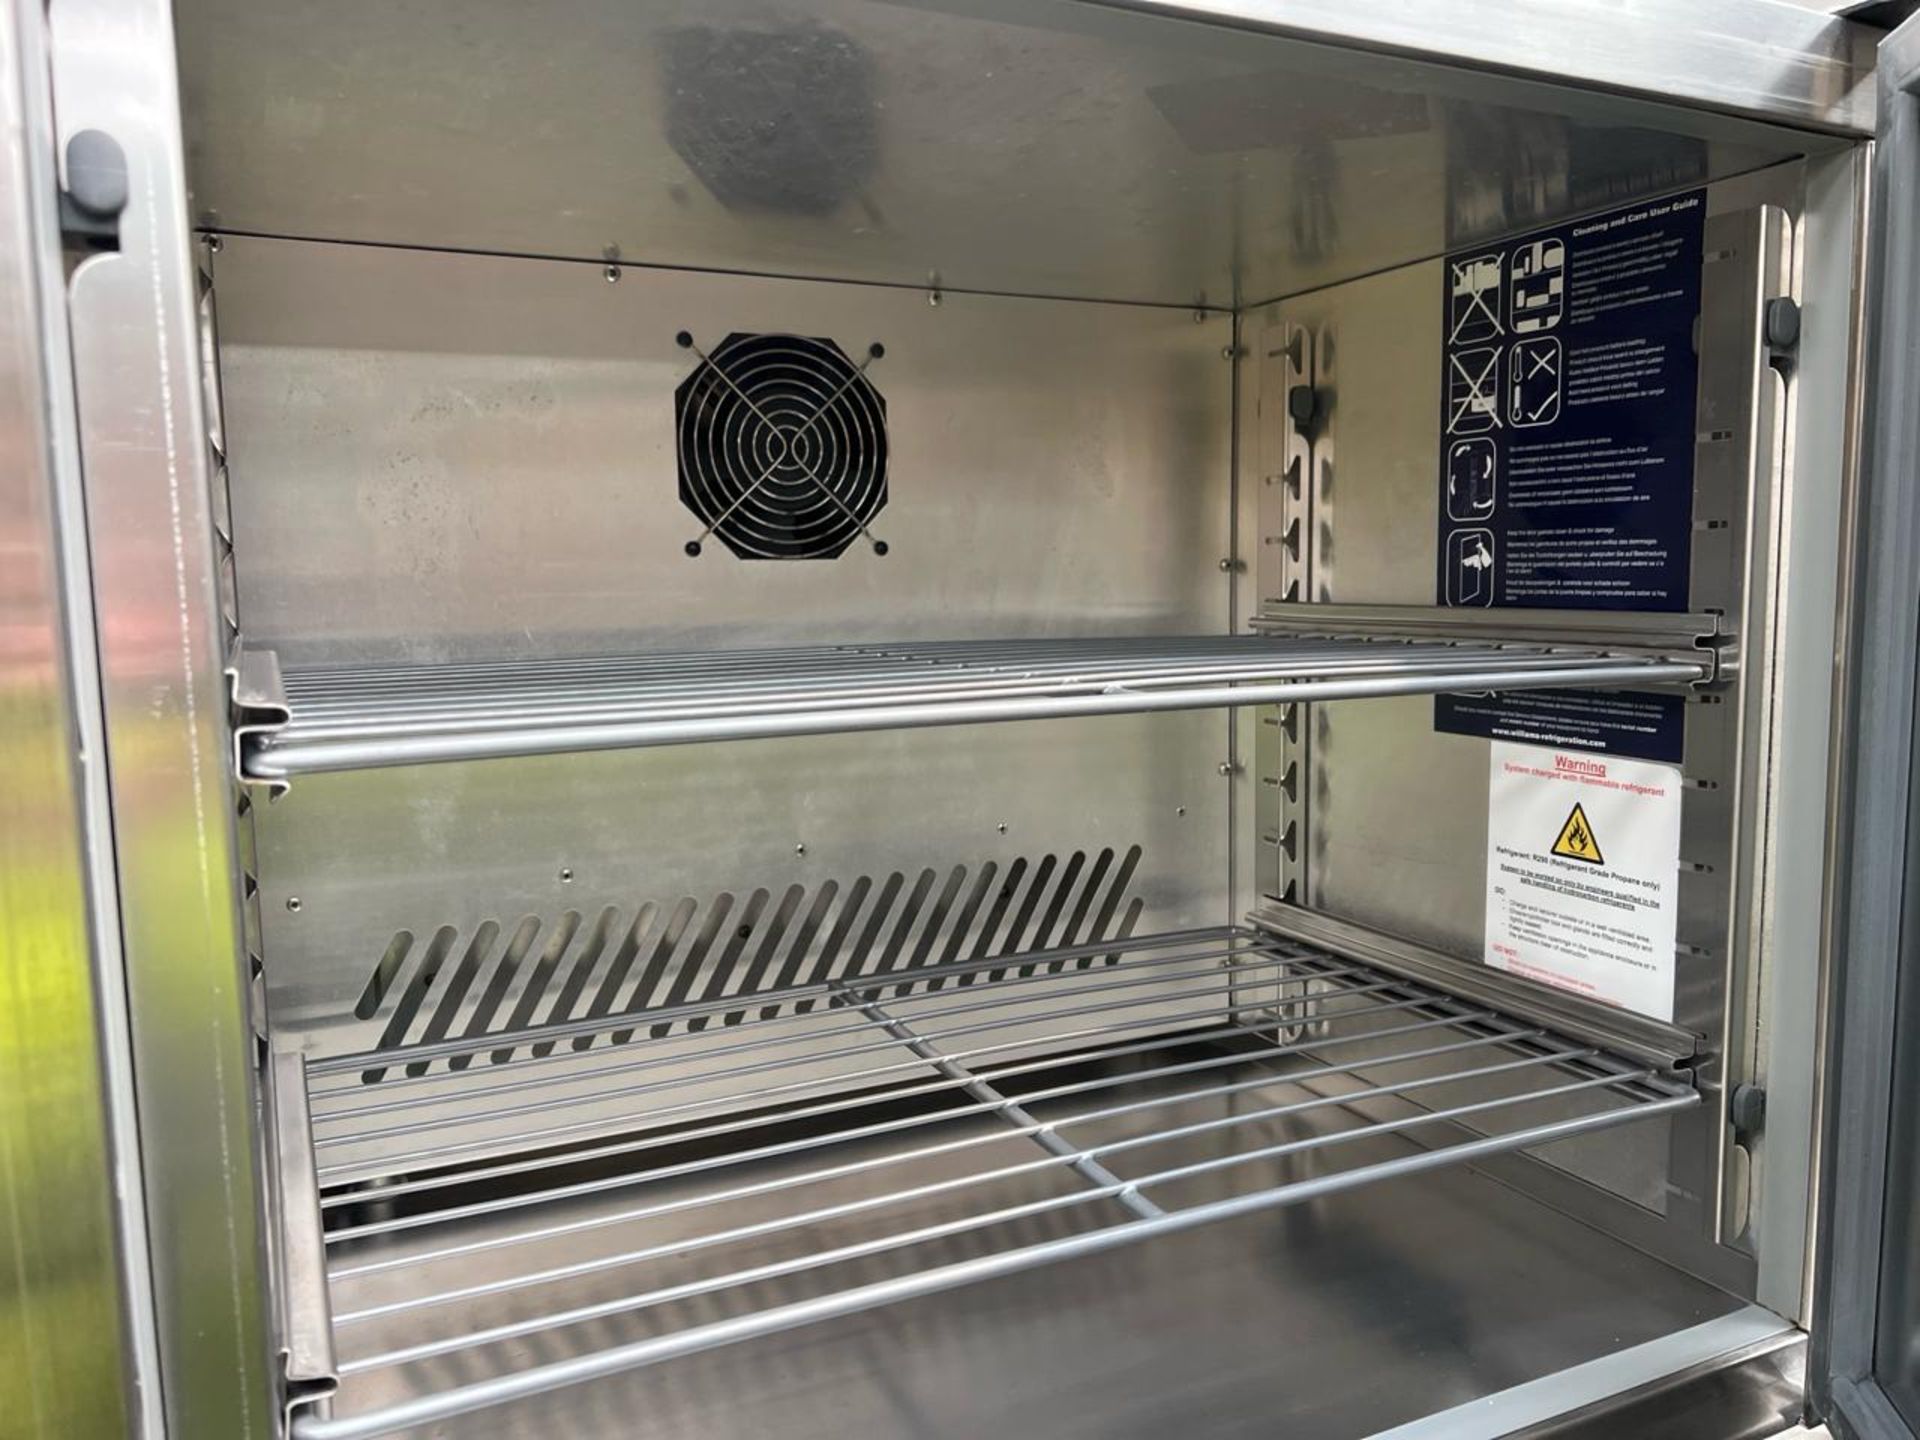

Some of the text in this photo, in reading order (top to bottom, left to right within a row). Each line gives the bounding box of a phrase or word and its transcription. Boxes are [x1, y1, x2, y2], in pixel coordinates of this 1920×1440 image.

[1610, 217, 1626, 228] and
[1628, 212, 1648, 222] Care
[1650, 206, 1671, 216] User
[1672, 199, 1698, 211] Guide
[1492, 727, 1606, 748] www.williams-refrigeration.com
[1555, 755, 1606, 774] Warning
[1504, 763, 1665, 797] System charged with flammable refrigerant
[1589, 867, 1610, 878] Grade
[1611, 872, 1641, 886] Propane
